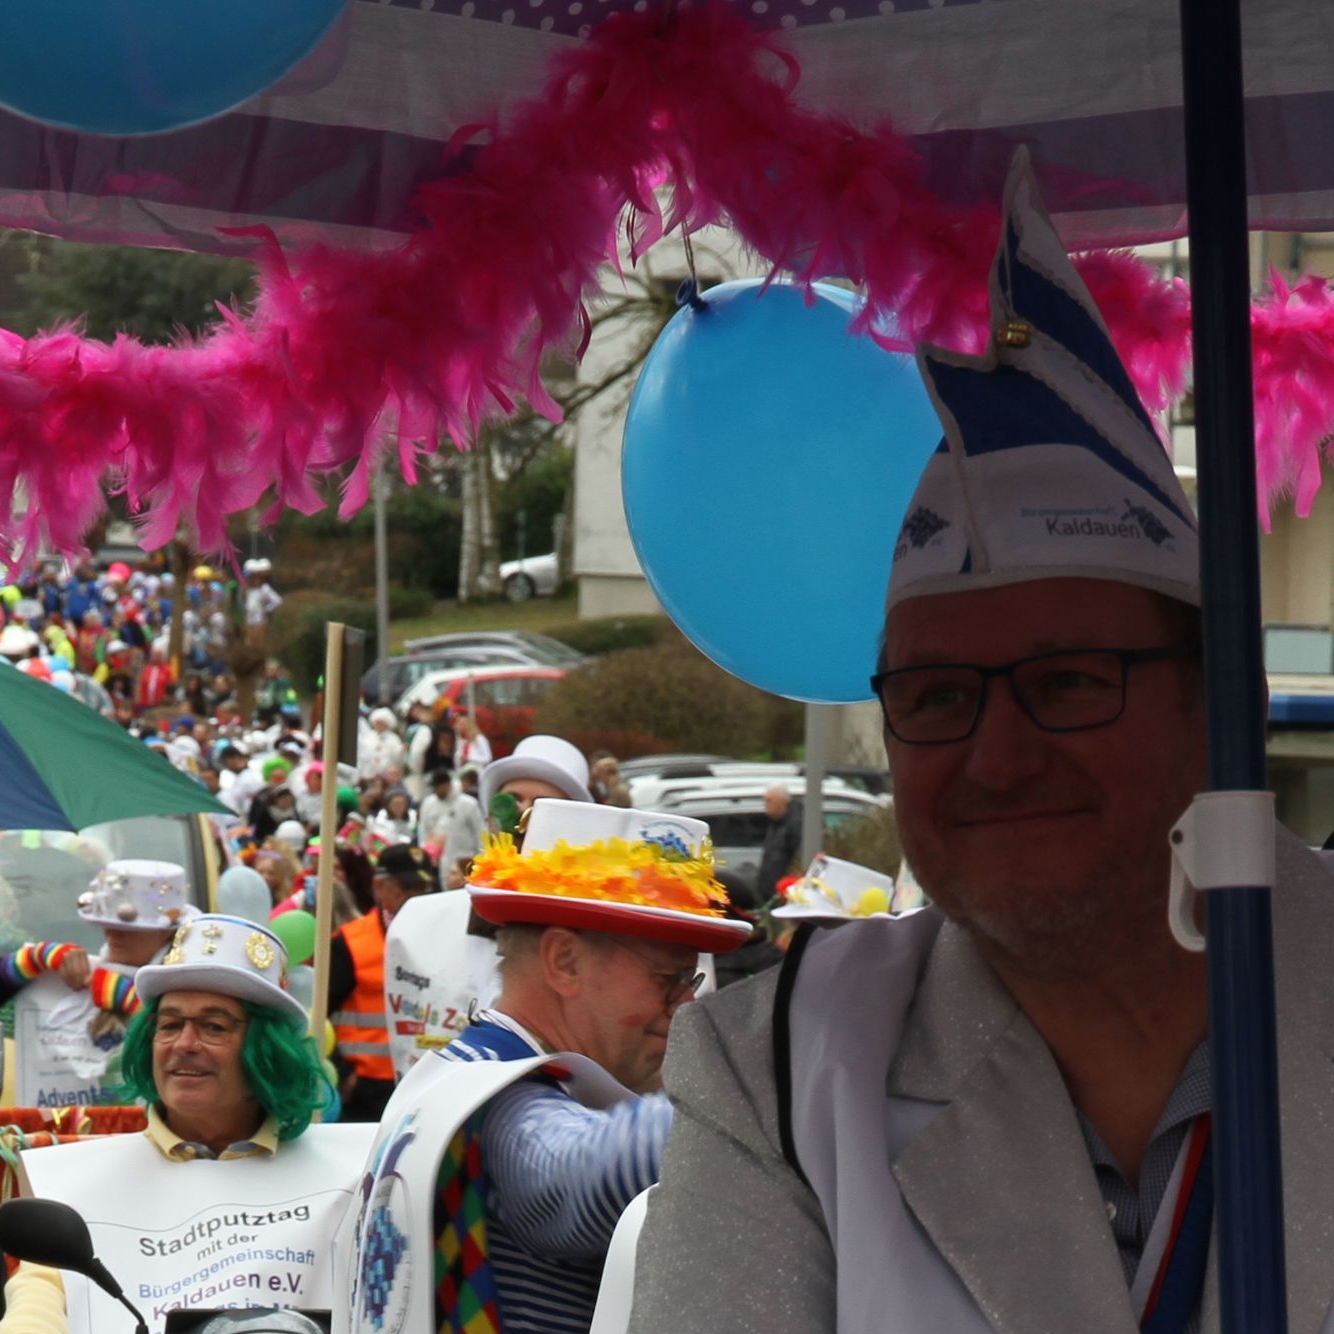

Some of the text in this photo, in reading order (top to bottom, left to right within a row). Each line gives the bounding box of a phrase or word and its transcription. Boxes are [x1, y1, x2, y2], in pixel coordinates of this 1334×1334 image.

[1046, 516, 1141, 540] Kaldauen
[138, 1204, 310, 1257] Stadtputztag
[197, 1233, 259, 1262] mit der
[138, 1246, 316, 1299] Bürgergemeinschaft
[268, 1272, 303, 1296] e.V.
